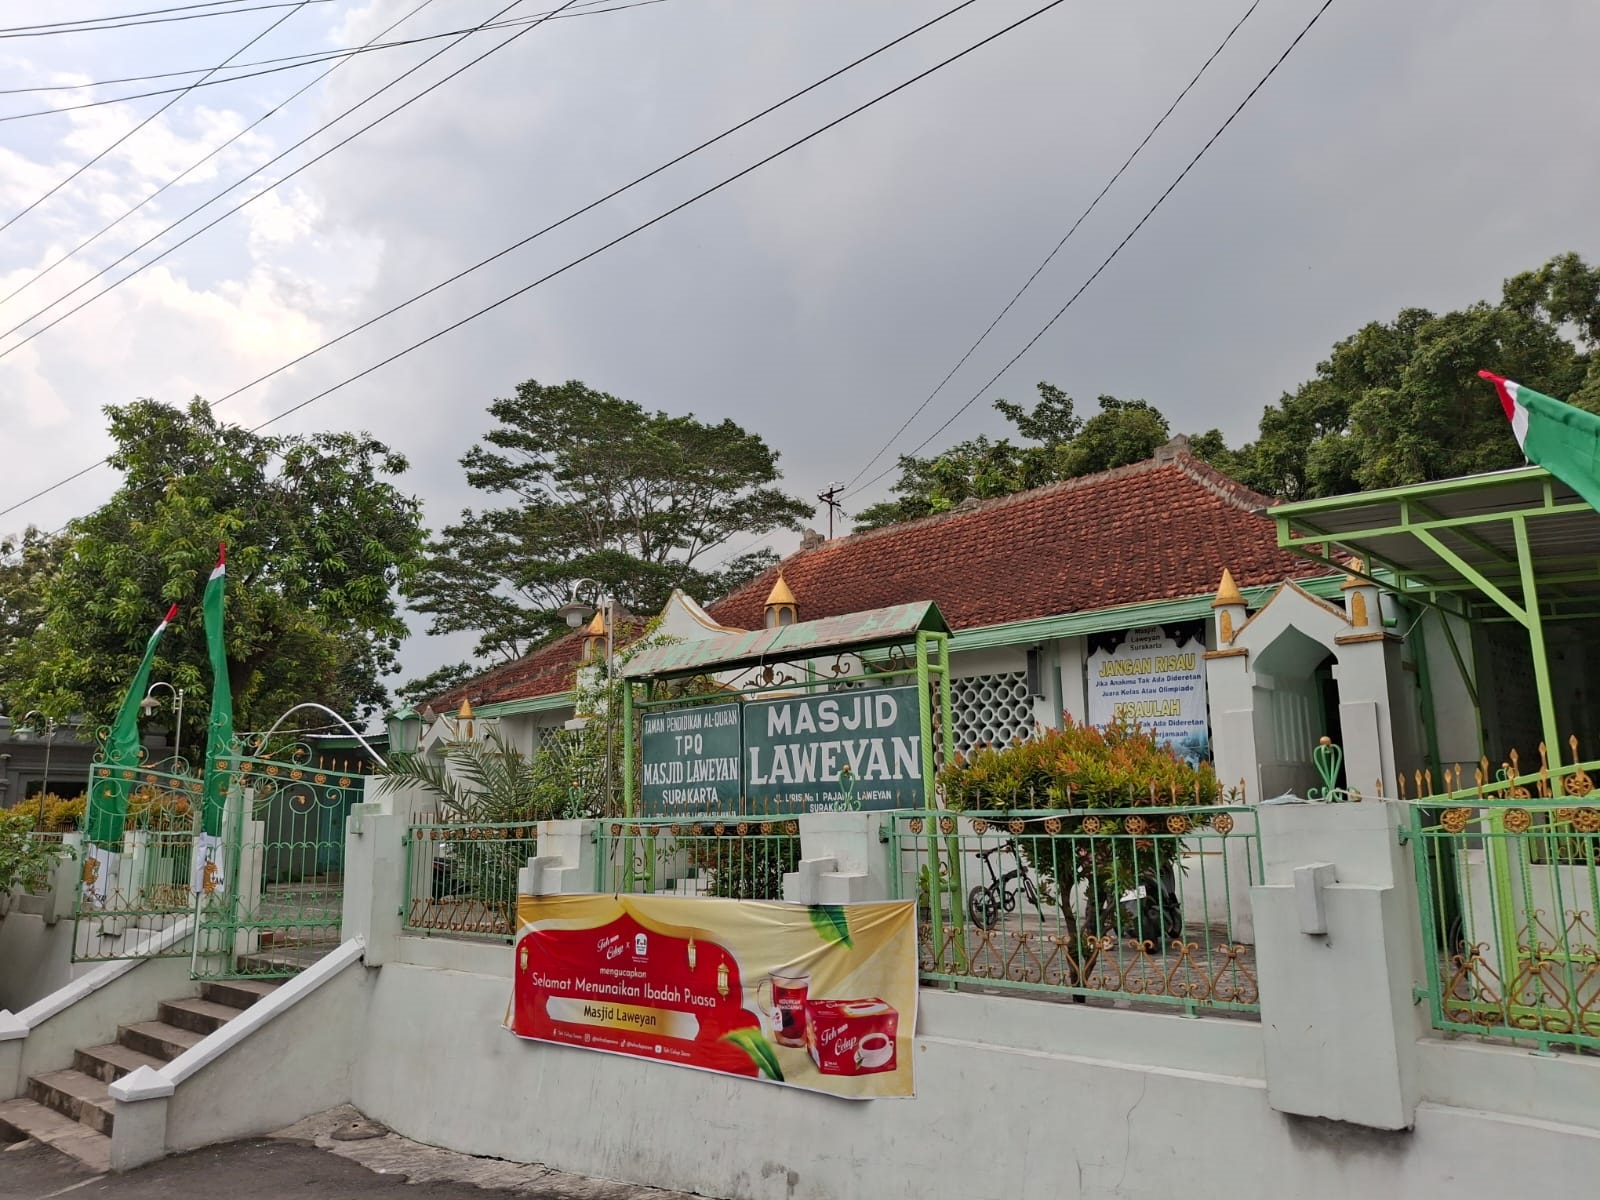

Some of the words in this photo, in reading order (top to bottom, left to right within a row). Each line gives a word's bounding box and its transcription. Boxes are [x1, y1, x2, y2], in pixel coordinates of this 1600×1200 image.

[1099, 658, 1152, 677] JANGAN
[1155, 653, 1196, 673] RISAU
[1167, 674, 1202, 682] Dideretan
[1121, 688, 1140, 696] Kelas
[1159, 685, 1194, 693] Olimpiade
[644, 718, 666, 735] TAMAN
[666, 713, 702, 733] PENDIDIKAN
[767, 694, 899, 737] MASJID
[1168, 719, 1204, 727] Dideretan
[675, 733, 703, 756] TPQ
[643, 761, 684, 786] MASJID
[686, 756, 739, 784] LAWEYAN
[749, 735, 922, 785] LAWEYAN
[662, 786, 719, 805] SURAKARTA
[857, 790, 892, 801] LAWEYAN
[599, 967, 647, 979] mengucapkan
[532, 972, 571, 990] Selamat
[575, 977, 640, 997] Menunaikan
[643, 983, 681, 1002] Ibadah
[684, 988, 716, 1008] Puasa
[583, 1005, 614, 1021] Masjid
[616, 1008, 657, 1027] Laweyan
